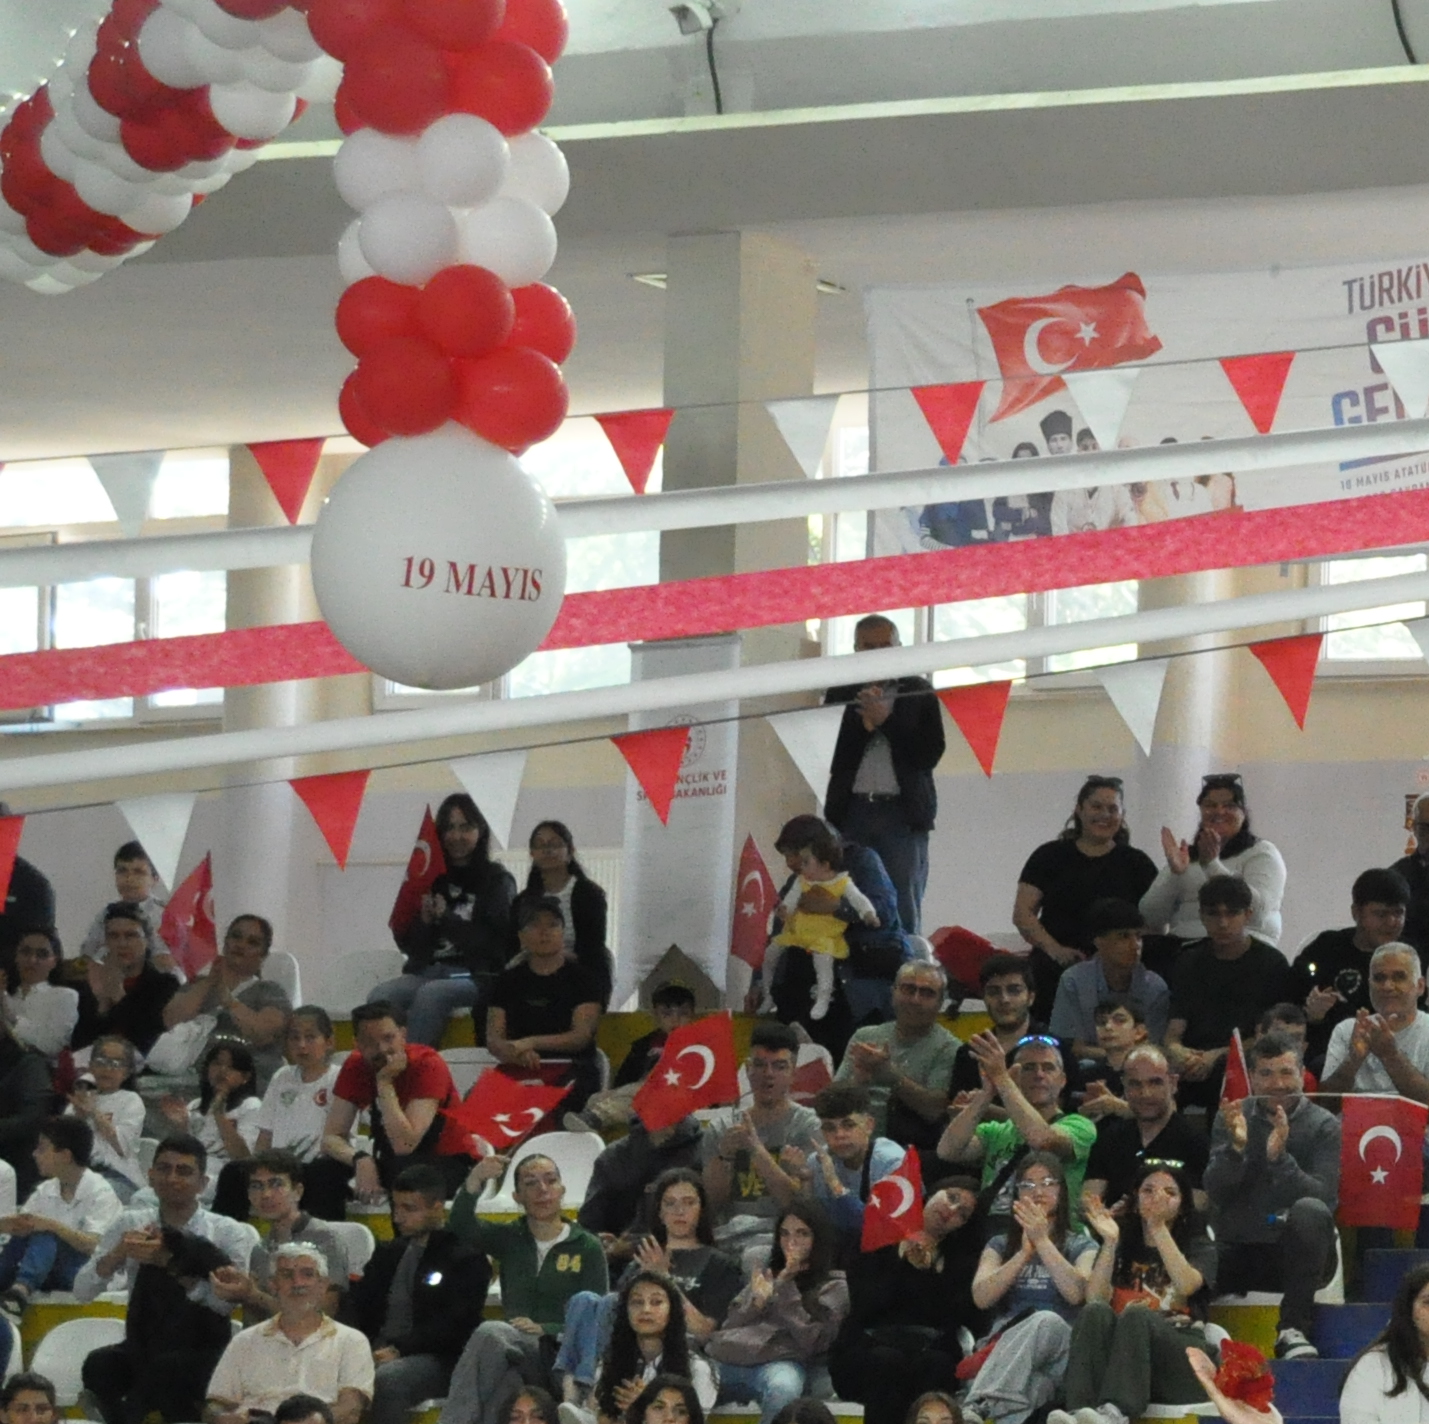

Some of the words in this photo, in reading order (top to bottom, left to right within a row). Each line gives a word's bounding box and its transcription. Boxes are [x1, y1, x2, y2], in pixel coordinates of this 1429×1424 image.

[400, 555, 435, 590] 19
[443, 560, 543, 602] MAYIS
[675, 784, 727, 799] AKANLIĞI
